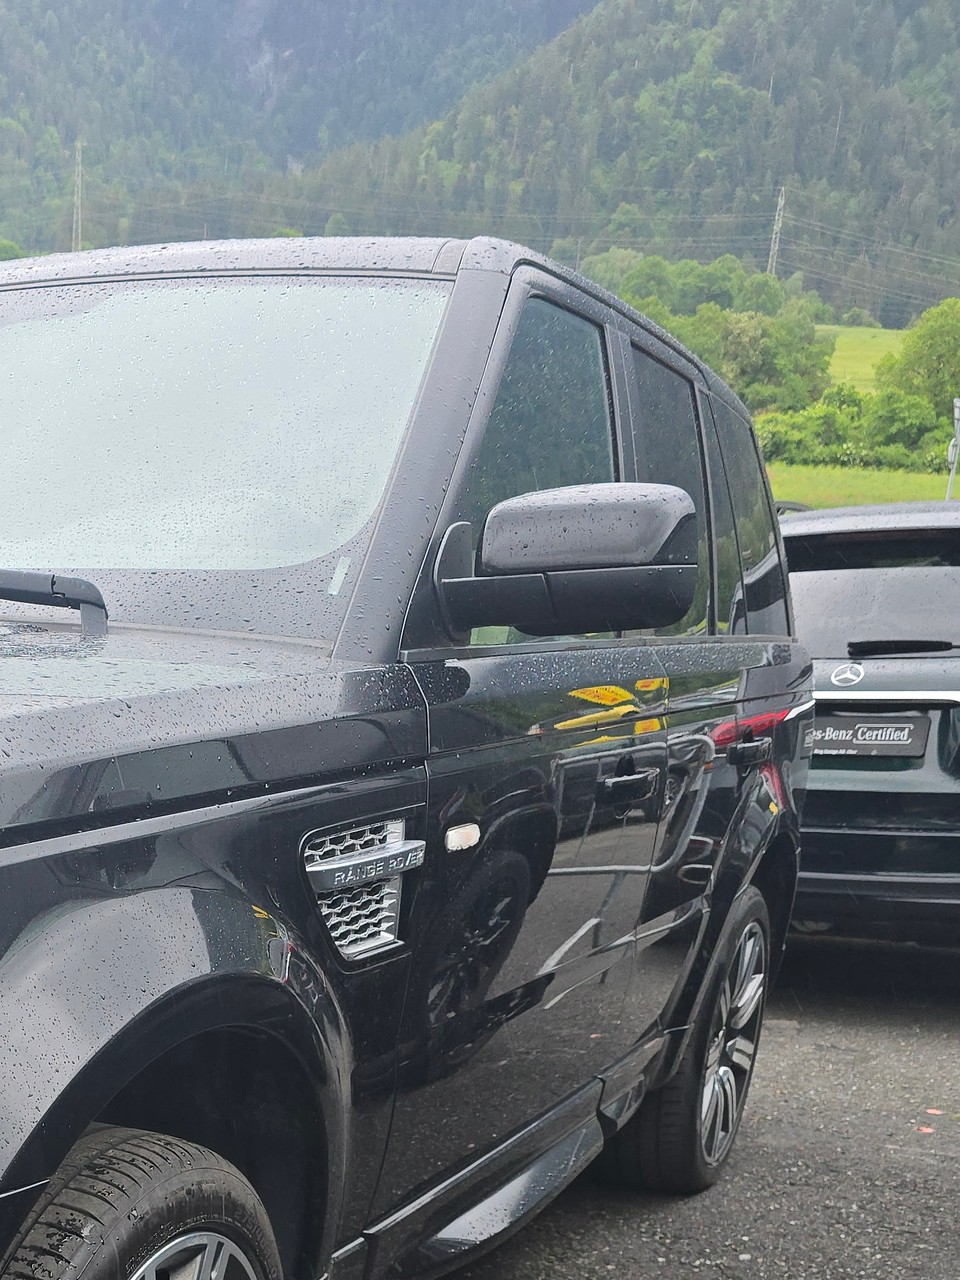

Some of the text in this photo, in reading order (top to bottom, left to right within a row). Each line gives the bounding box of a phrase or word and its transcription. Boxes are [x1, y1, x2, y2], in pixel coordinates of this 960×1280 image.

[857, 726, 910, 741] Certified
[334, 848, 424, 885] RANGE ROVER
